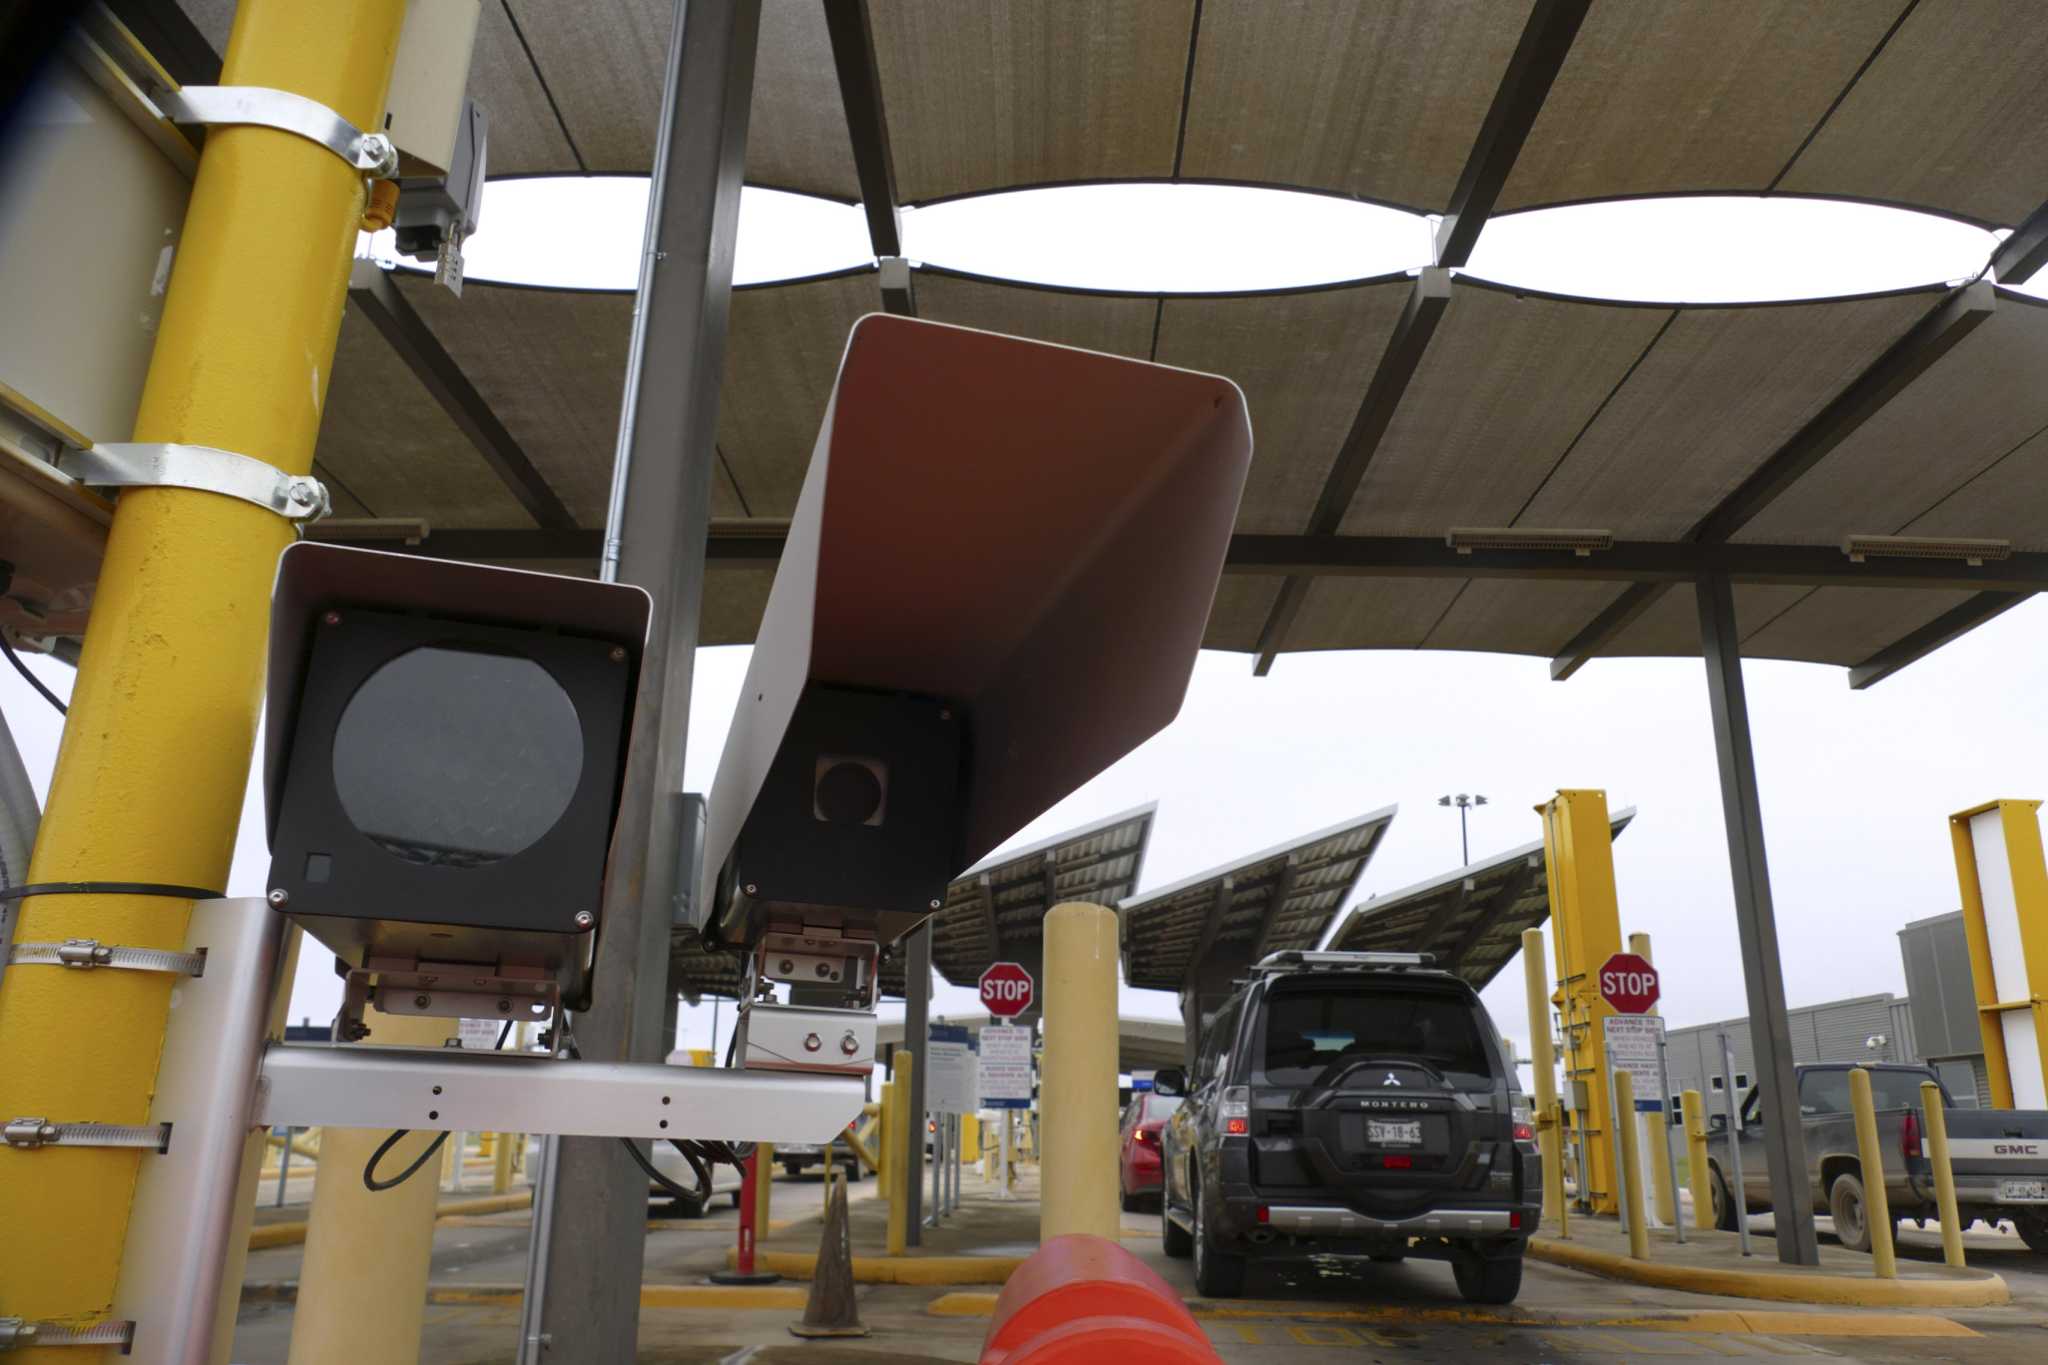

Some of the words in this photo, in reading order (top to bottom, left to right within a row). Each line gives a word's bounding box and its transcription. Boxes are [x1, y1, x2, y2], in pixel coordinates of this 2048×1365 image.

[983, 980, 1029, 1000] STOP
[1603, 972, 1655, 995] STOP
[1360, 1101, 1428, 1109] MONTERO
[1994, 1144, 2038, 1155] GMC
